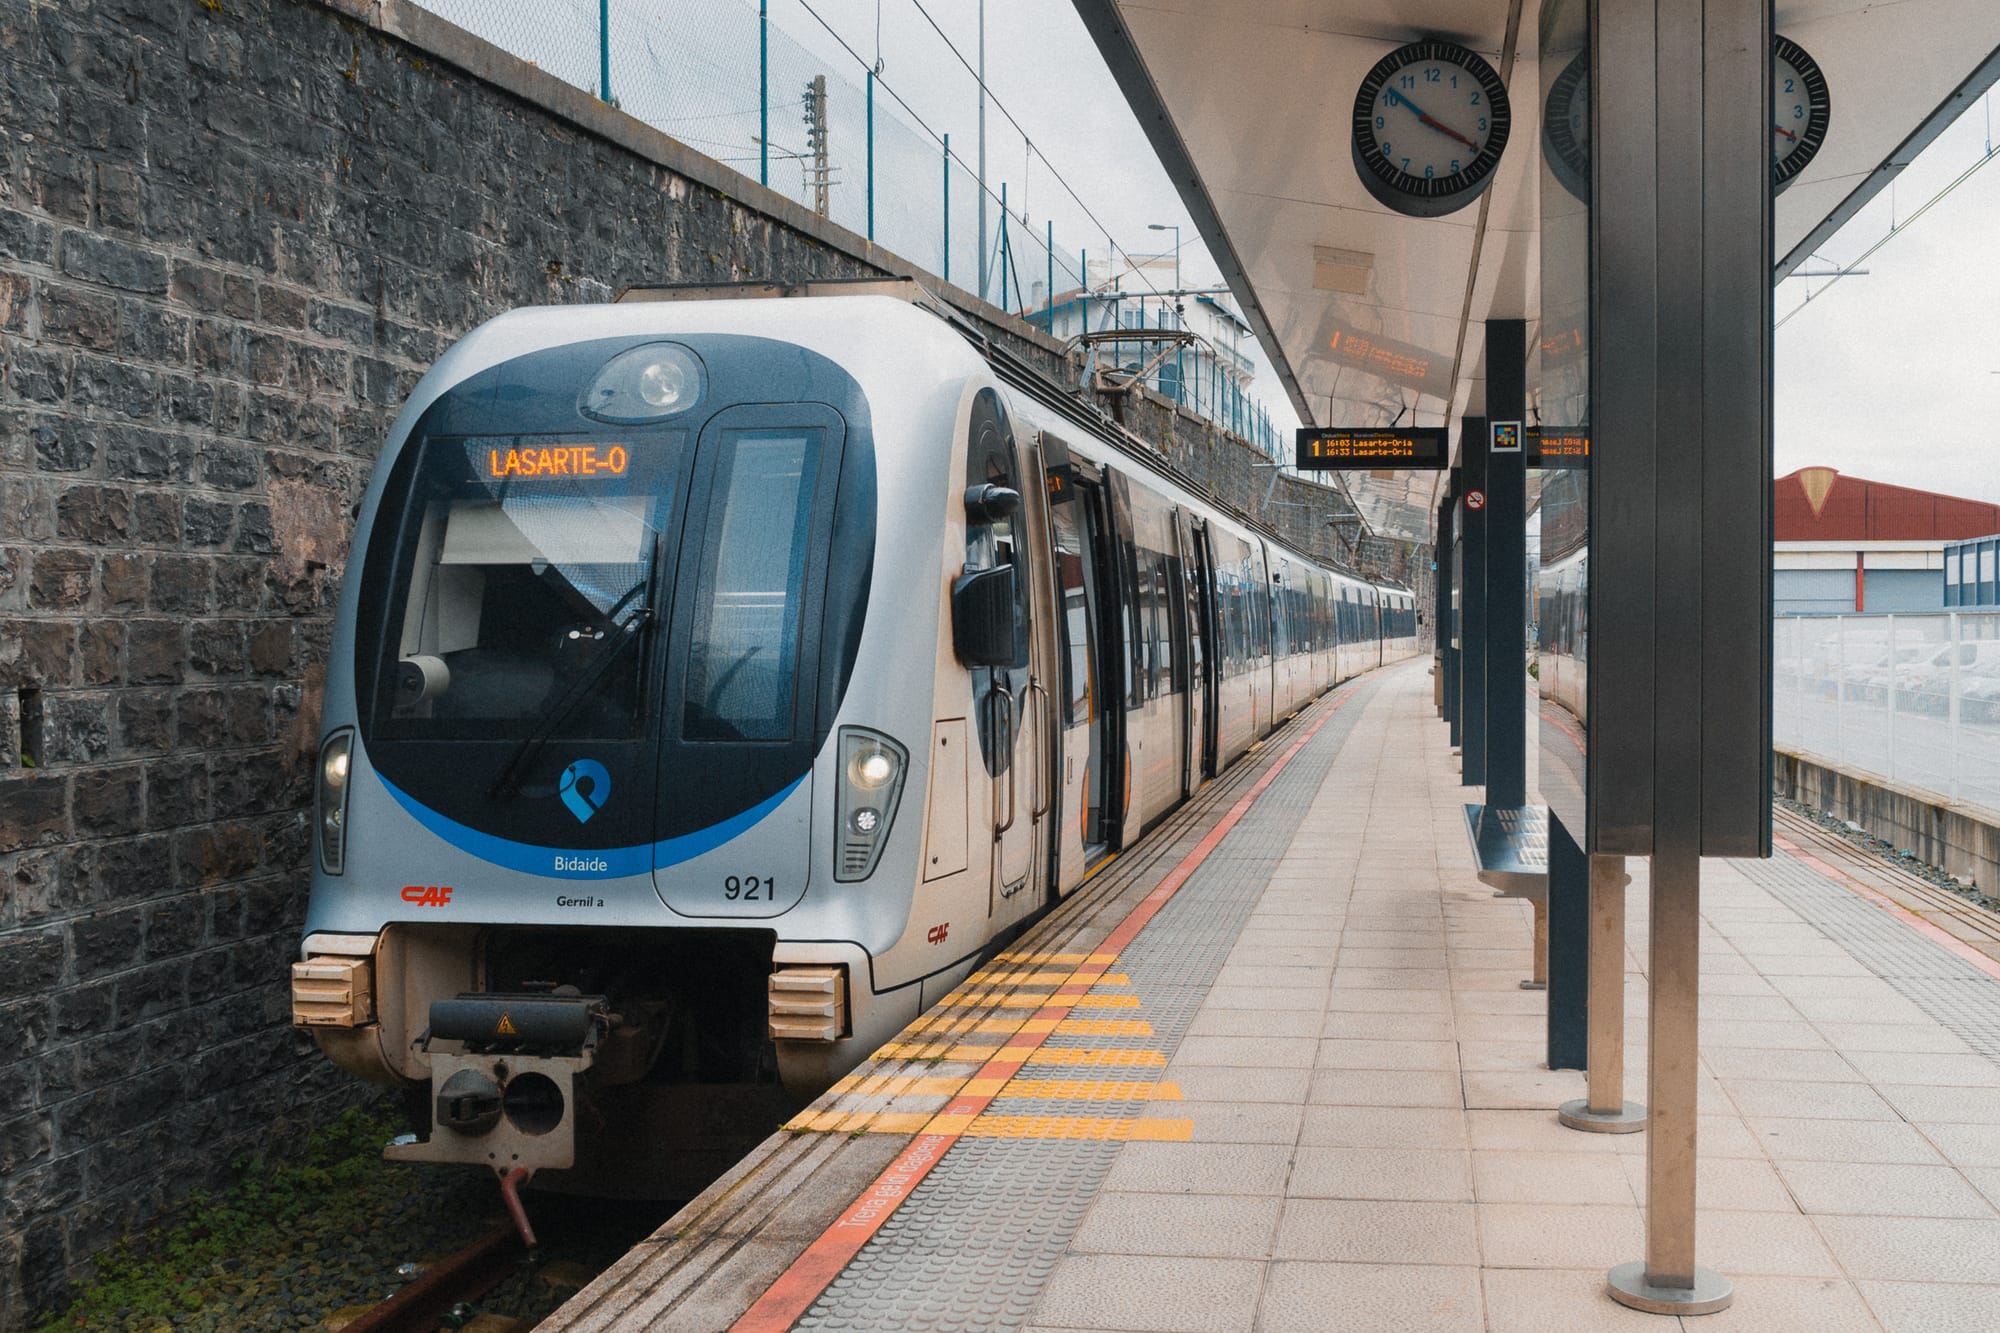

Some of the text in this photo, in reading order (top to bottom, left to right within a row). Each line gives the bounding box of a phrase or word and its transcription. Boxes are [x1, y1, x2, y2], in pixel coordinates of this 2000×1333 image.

[1400, 75, 1415, 89] 11
[1424, 68, 1440, 82] 12
[1450, 76, 1457, 89] 1
[1784, 79, 1794, 93] 2
[1383, 94, 1399, 107] 10
[1471, 92, 1480, 105] 2
[1793, 105, 1803, 119] 3
[1375, 116, 1385, 130] 9
[1478, 117, 1487, 131] 3
[1382, 142, 1391, 155] 8
[1401, 158, 1410, 171] 7
[1450, 160, 1460, 173] 5
[1425, 166, 1434, 179] 6
[1312, 440, 1320, 456] 1
[1326, 439, 1413, 447] 16:03 Lasarte-Oria
[1326, 448, 1413, 456] 16:33 Lasarte-Oria
[554, 856, 608, 872] Bidaide
[725, 875, 774, 901] 921
[400, 886, 454, 907] CAF
[928, 922, 950, 945] CAF
[838, 1197, 887, 1228] Trena
[875, 1173, 913, 1197] geldi
